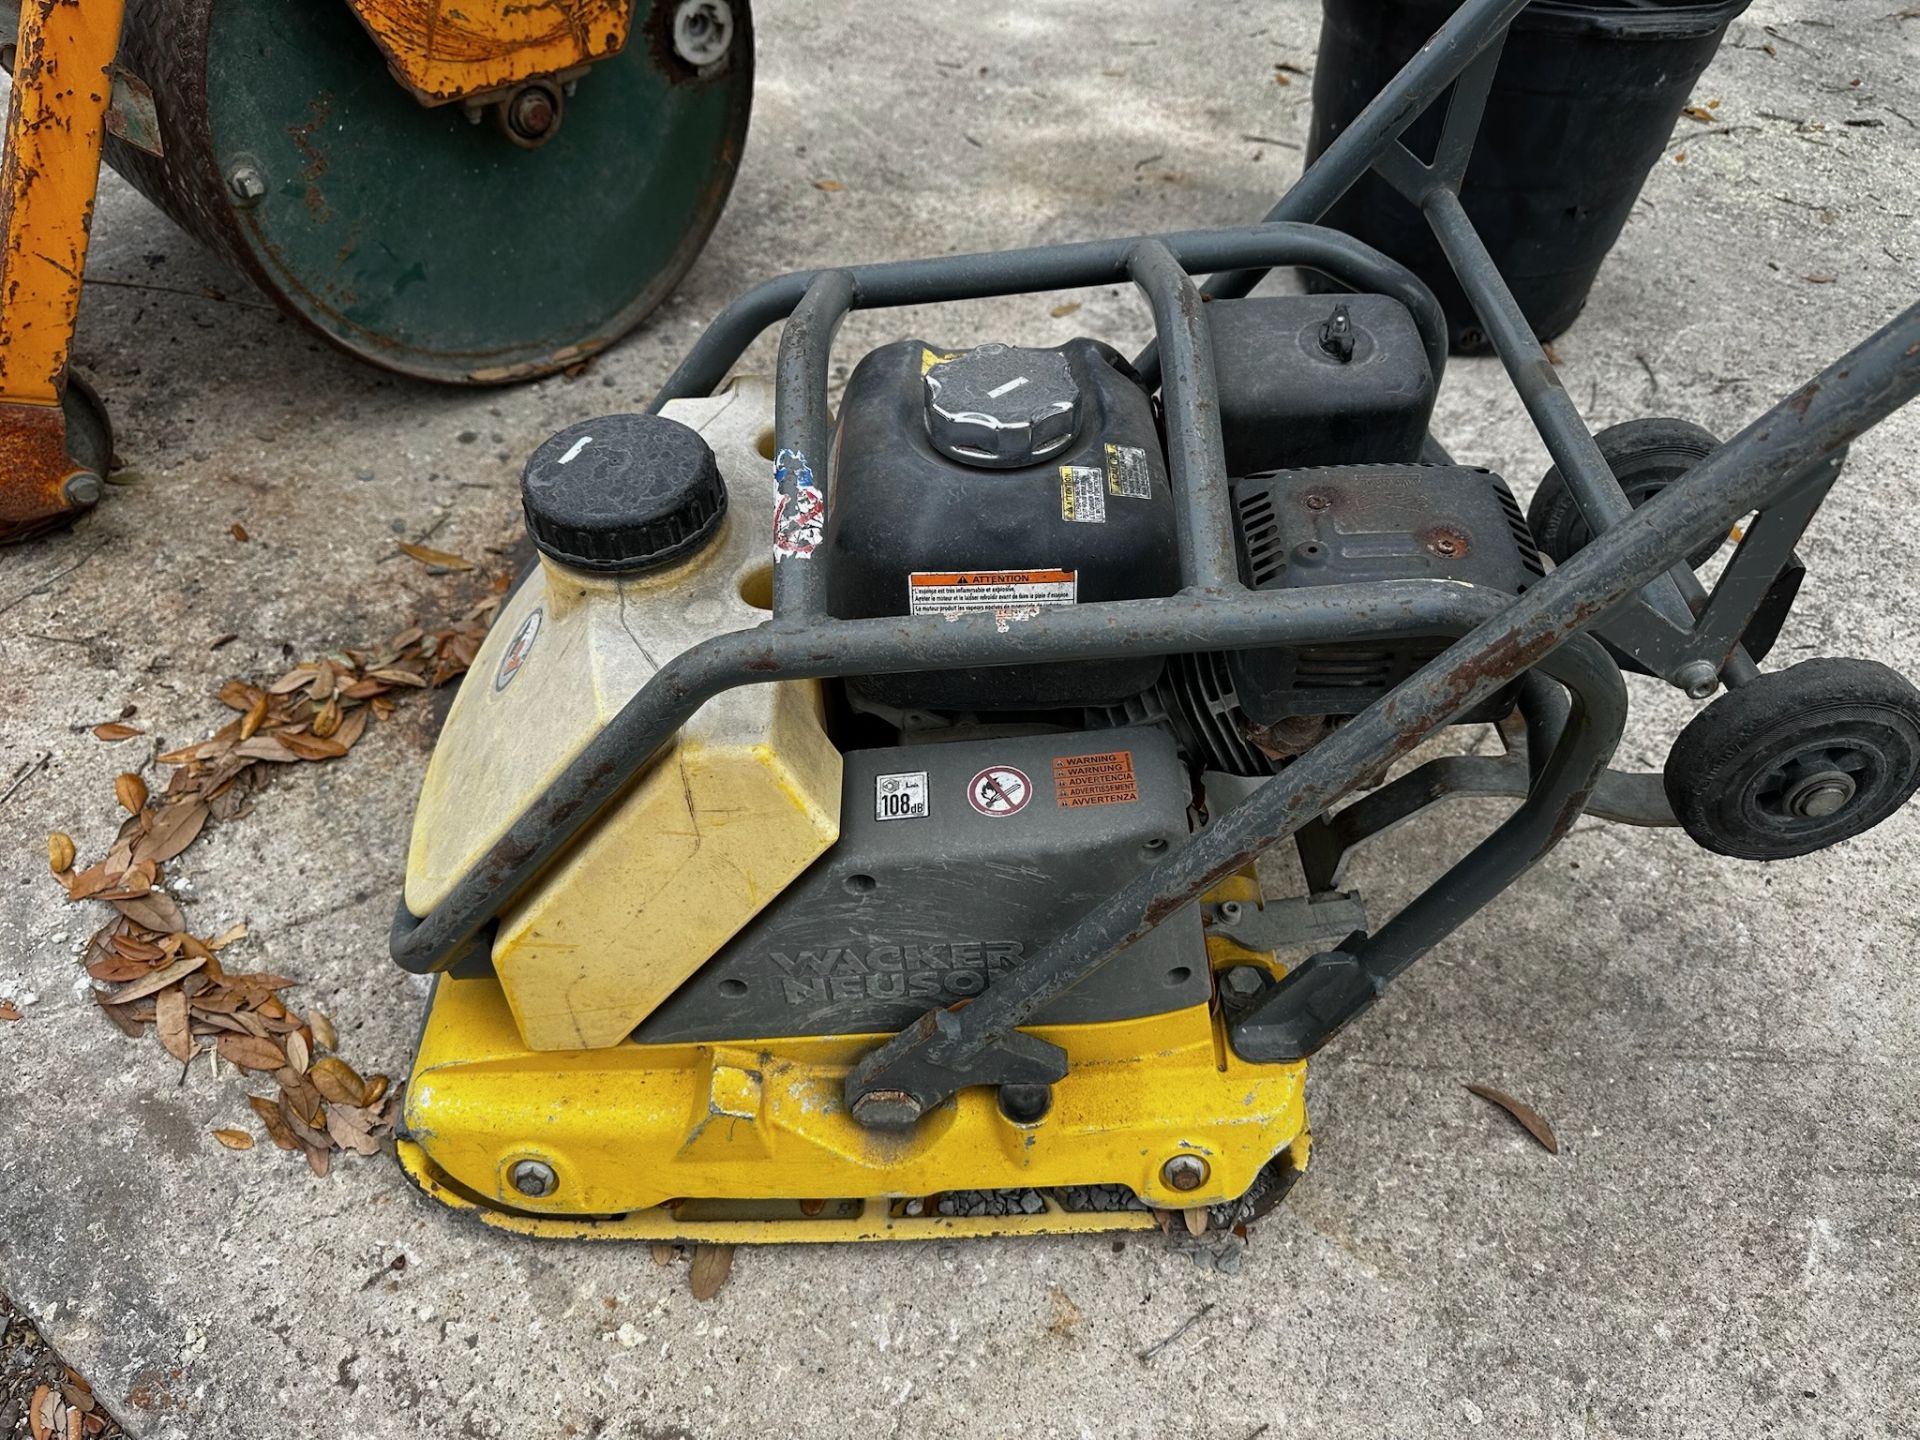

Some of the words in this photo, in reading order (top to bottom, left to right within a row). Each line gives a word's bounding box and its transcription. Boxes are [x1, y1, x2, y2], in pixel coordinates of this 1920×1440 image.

[1064, 473, 1073, 506] ATTENTION
[973, 575, 1029, 583] ATTENTION
[1066, 754, 1117, 765] WARNING
[1067, 763, 1123, 776] WARNUNG
[1069, 773, 1133, 785] ADVERTENCIA
[1070, 783, 1134, 796] ADVERTISSEMENT
[1071, 793, 1137, 806] AVVERTENZA
[769, 940, 1026, 976] WACKER
